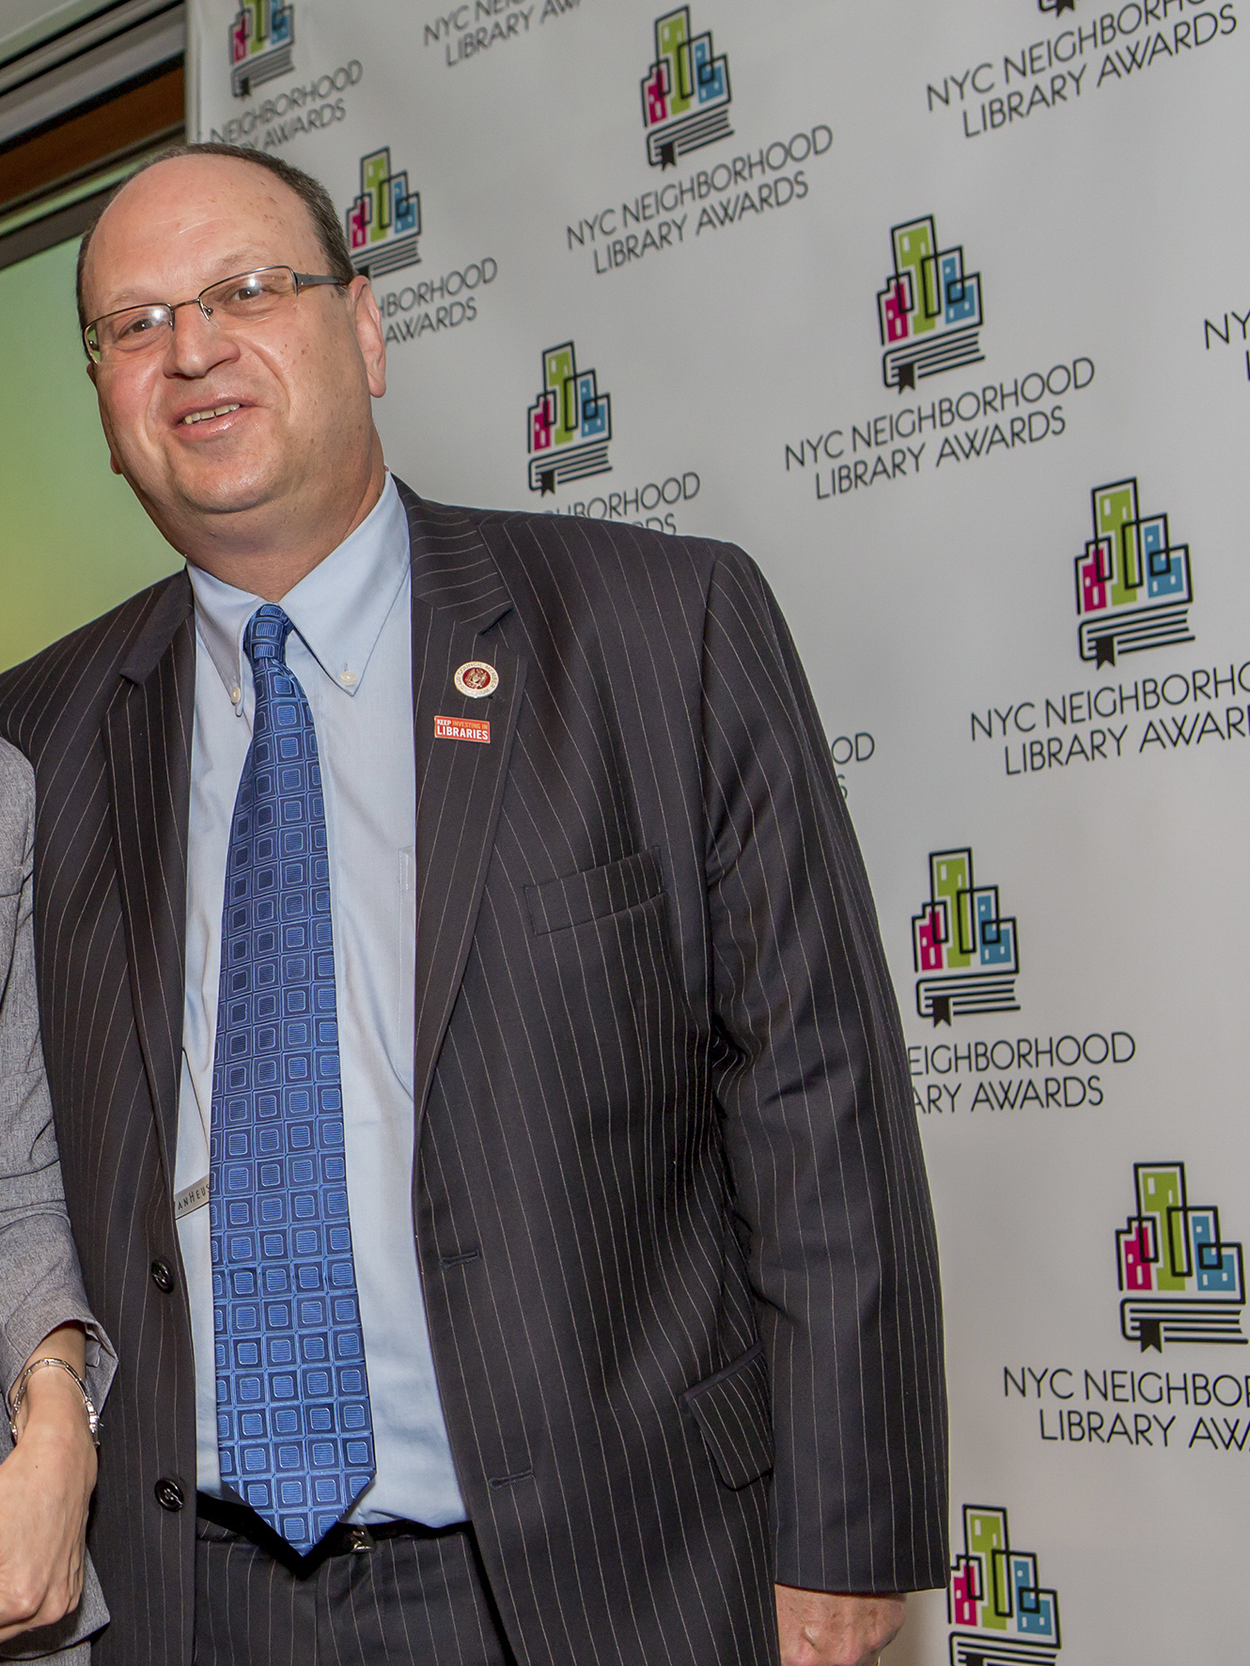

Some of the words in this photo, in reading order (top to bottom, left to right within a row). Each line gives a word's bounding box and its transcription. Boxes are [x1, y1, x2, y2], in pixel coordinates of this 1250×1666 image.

[423, 4, 470, 47] NYC
[446, 4, 535, 68] LIBRARY
[926, 62, 996, 112] NYC
[963, 63, 1088, 138] LIBRARY
[1097, 3, 1237, 88] AWARDS
[262, 97, 347, 150] AWARDS
[566, 208, 617, 250] NYC
[622, 124, 833, 229] NEIGHBORHOOD
[593, 213, 688, 274] LIBRARY
[695, 170, 809, 236] AWARDS
[384, 296, 478, 347] AWARDS
[1204, 309, 1250, 350] NY
[784, 430, 845, 472] NYC
[852, 357, 1095, 453] NEIGHBORHOOD
[815, 442, 926, 500] LIBRARY
[936, 405, 1066, 468] AWARDS
[437, 725, 489, 740] LIBRARIES
[970, 702, 1037, 742] NYC
[1004, 723, 1129, 776] LIBRARY
[1139, 703, 1250, 754] AWAR
[907, 1031, 1137, 1076] EIGHBORHOOD
[970, 1074, 1104, 1113] AWARDS
[1003, 1366, 1075, 1400] NYC
[1039, 1408, 1177, 1448] LIBRARY
